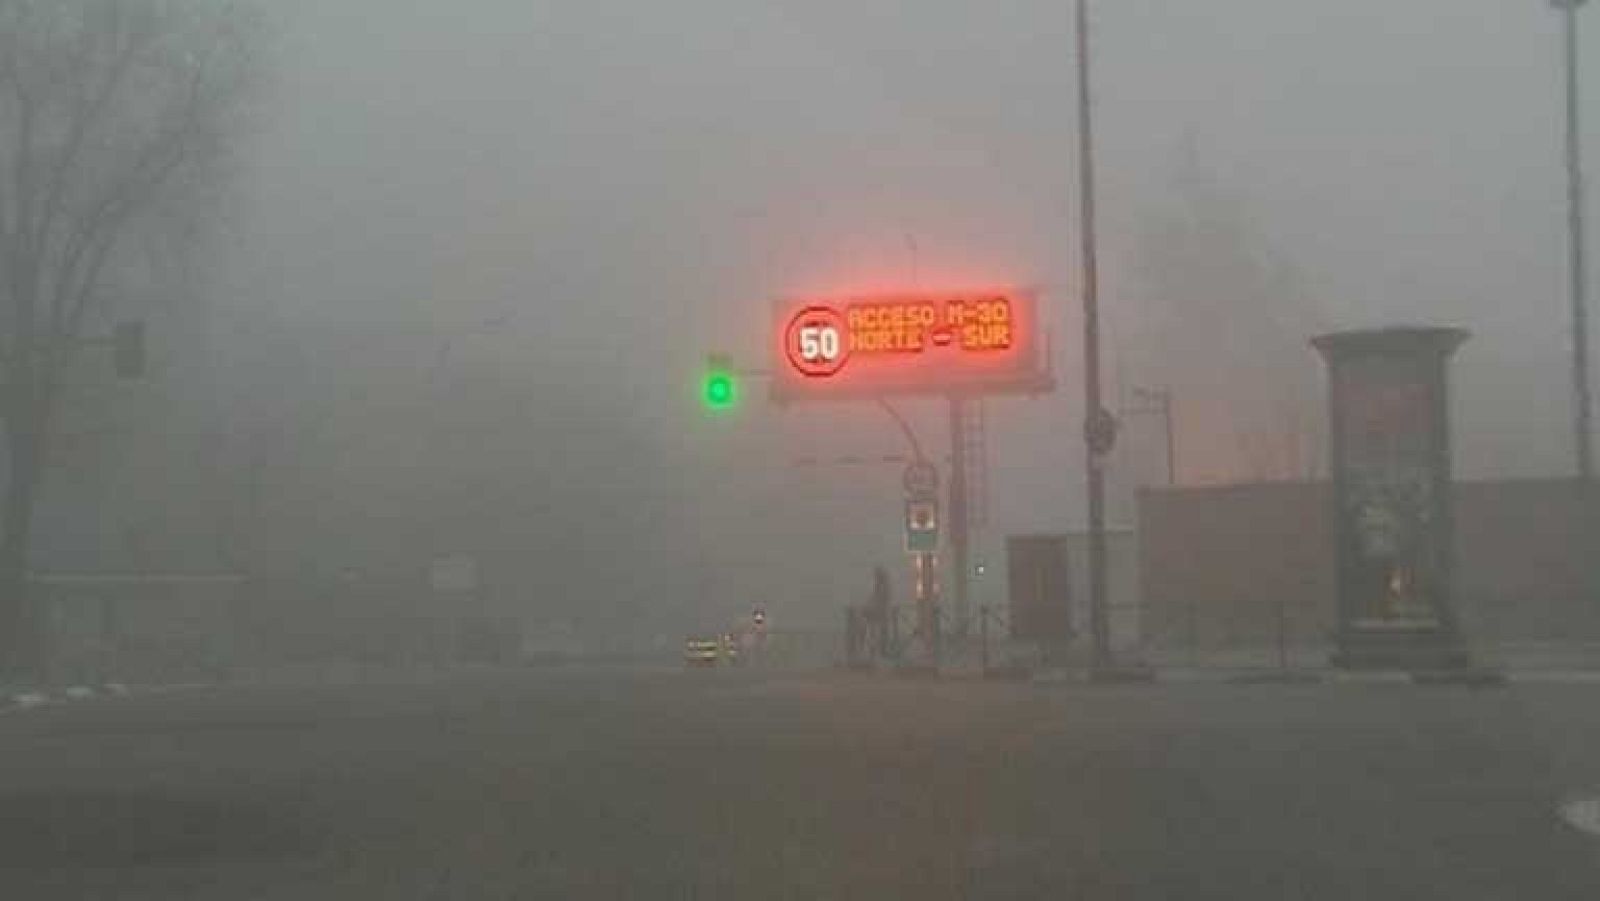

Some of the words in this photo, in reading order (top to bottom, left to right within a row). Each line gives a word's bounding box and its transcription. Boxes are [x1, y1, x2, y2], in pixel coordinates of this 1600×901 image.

[849, 306, 934, 327] ACCESO
[949, 302, 1008, 324] M-30
[801, 327, 839, 360] 50
[849, 331, 923, 351] NORTE
[964, 325, 1010, 347] SUR
